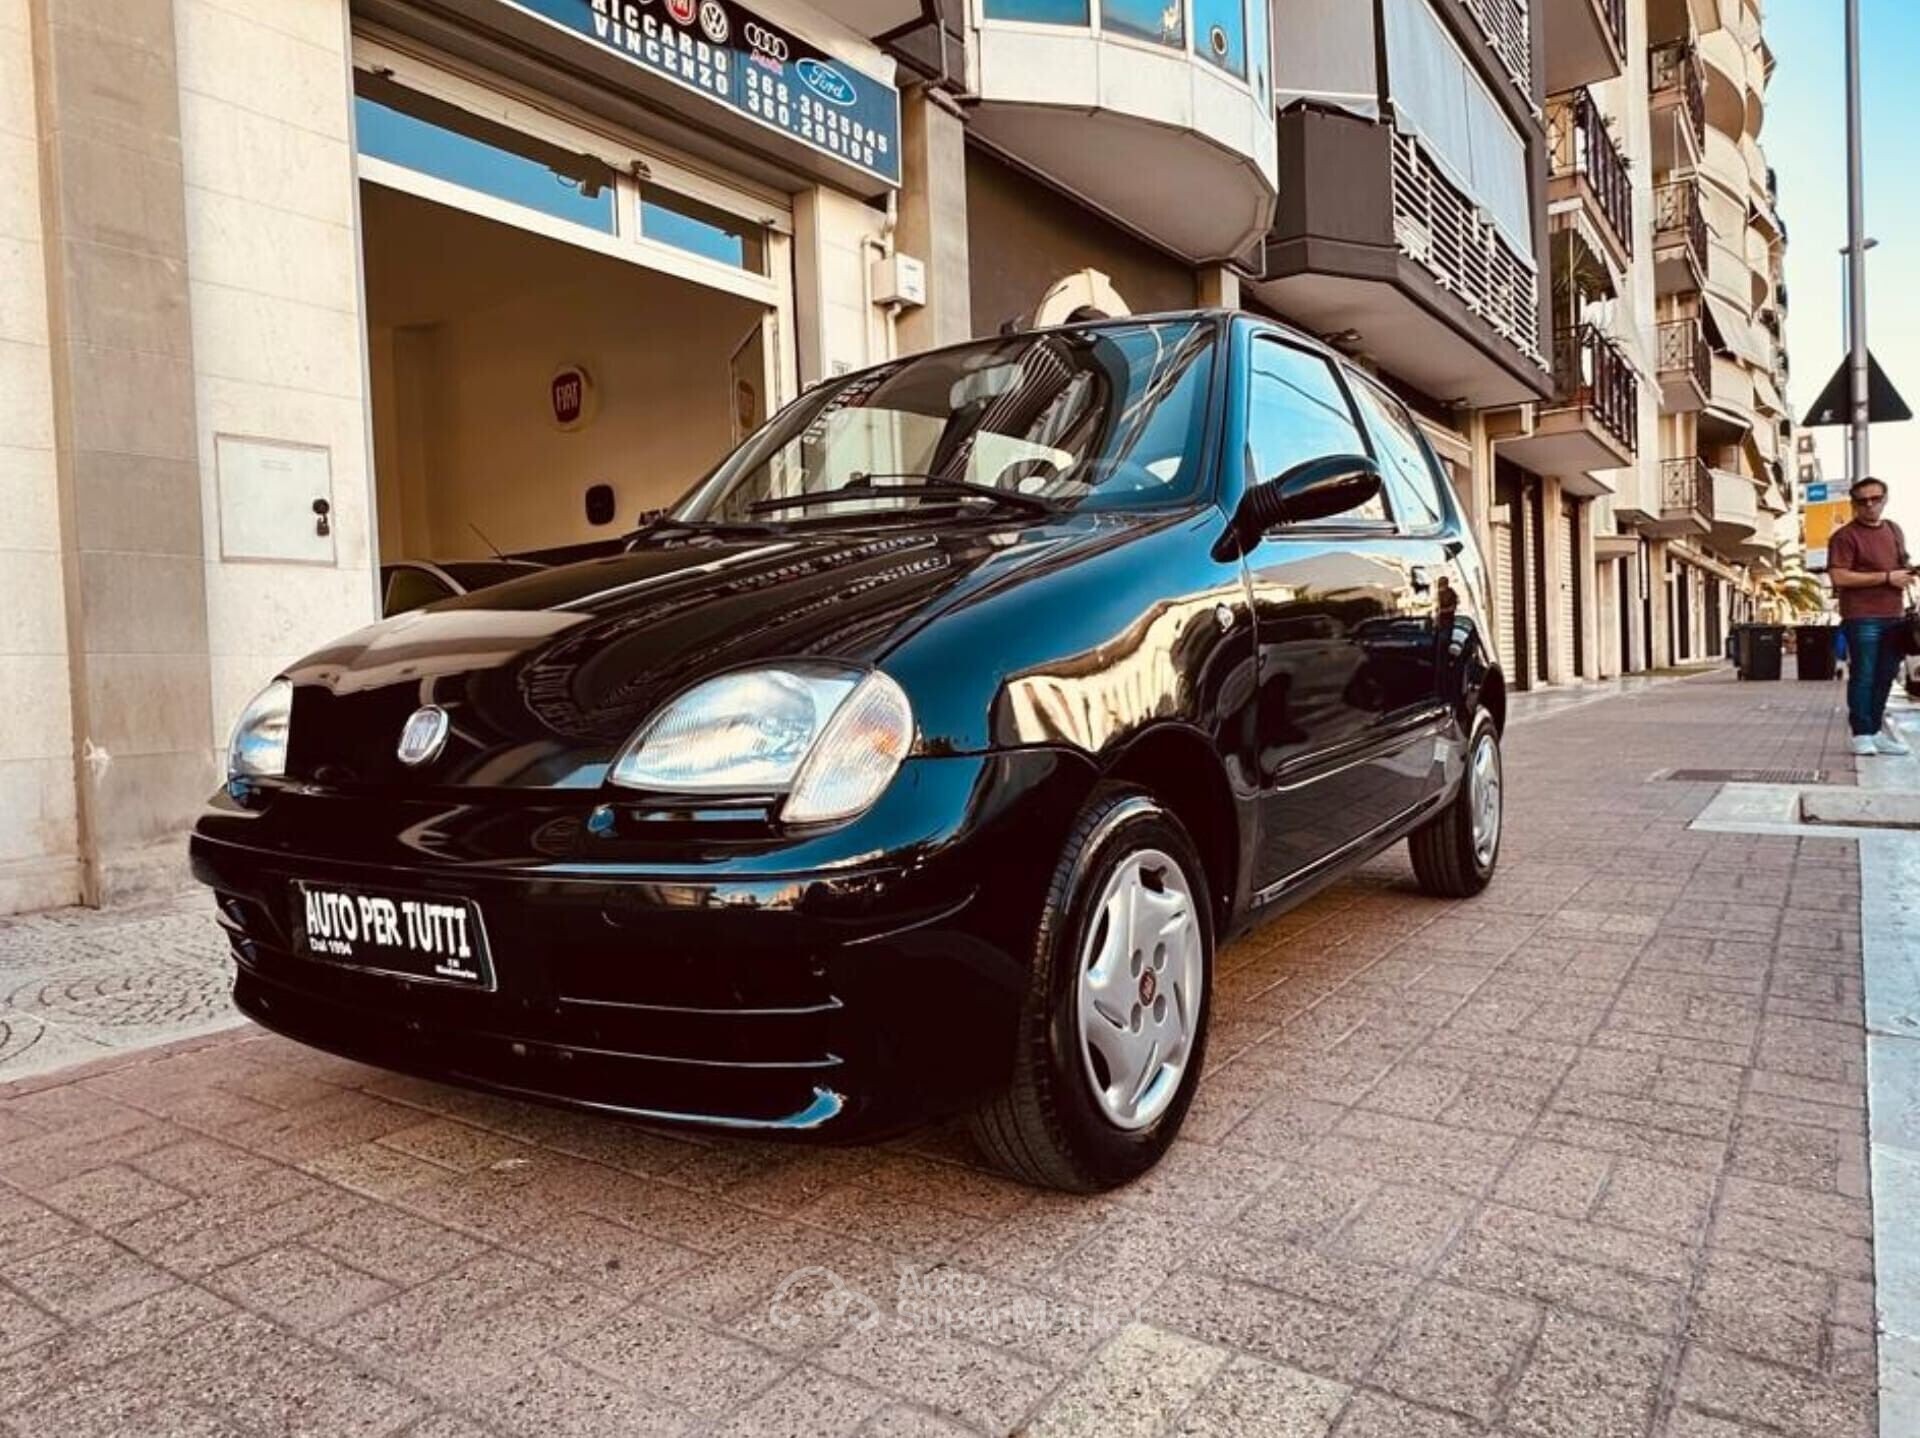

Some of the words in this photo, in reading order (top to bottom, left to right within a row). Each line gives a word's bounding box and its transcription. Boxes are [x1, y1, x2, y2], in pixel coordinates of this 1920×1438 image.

[593, 12, 728, 95] VINCENZO
[809, 64, 846, 99] Ford
[556, 381, 578, 412] FIAT
[306, 891, 357, 941] AUTO
[357, 896, 403, 946] PER
[402, 902, 471, 958] TUTTI
